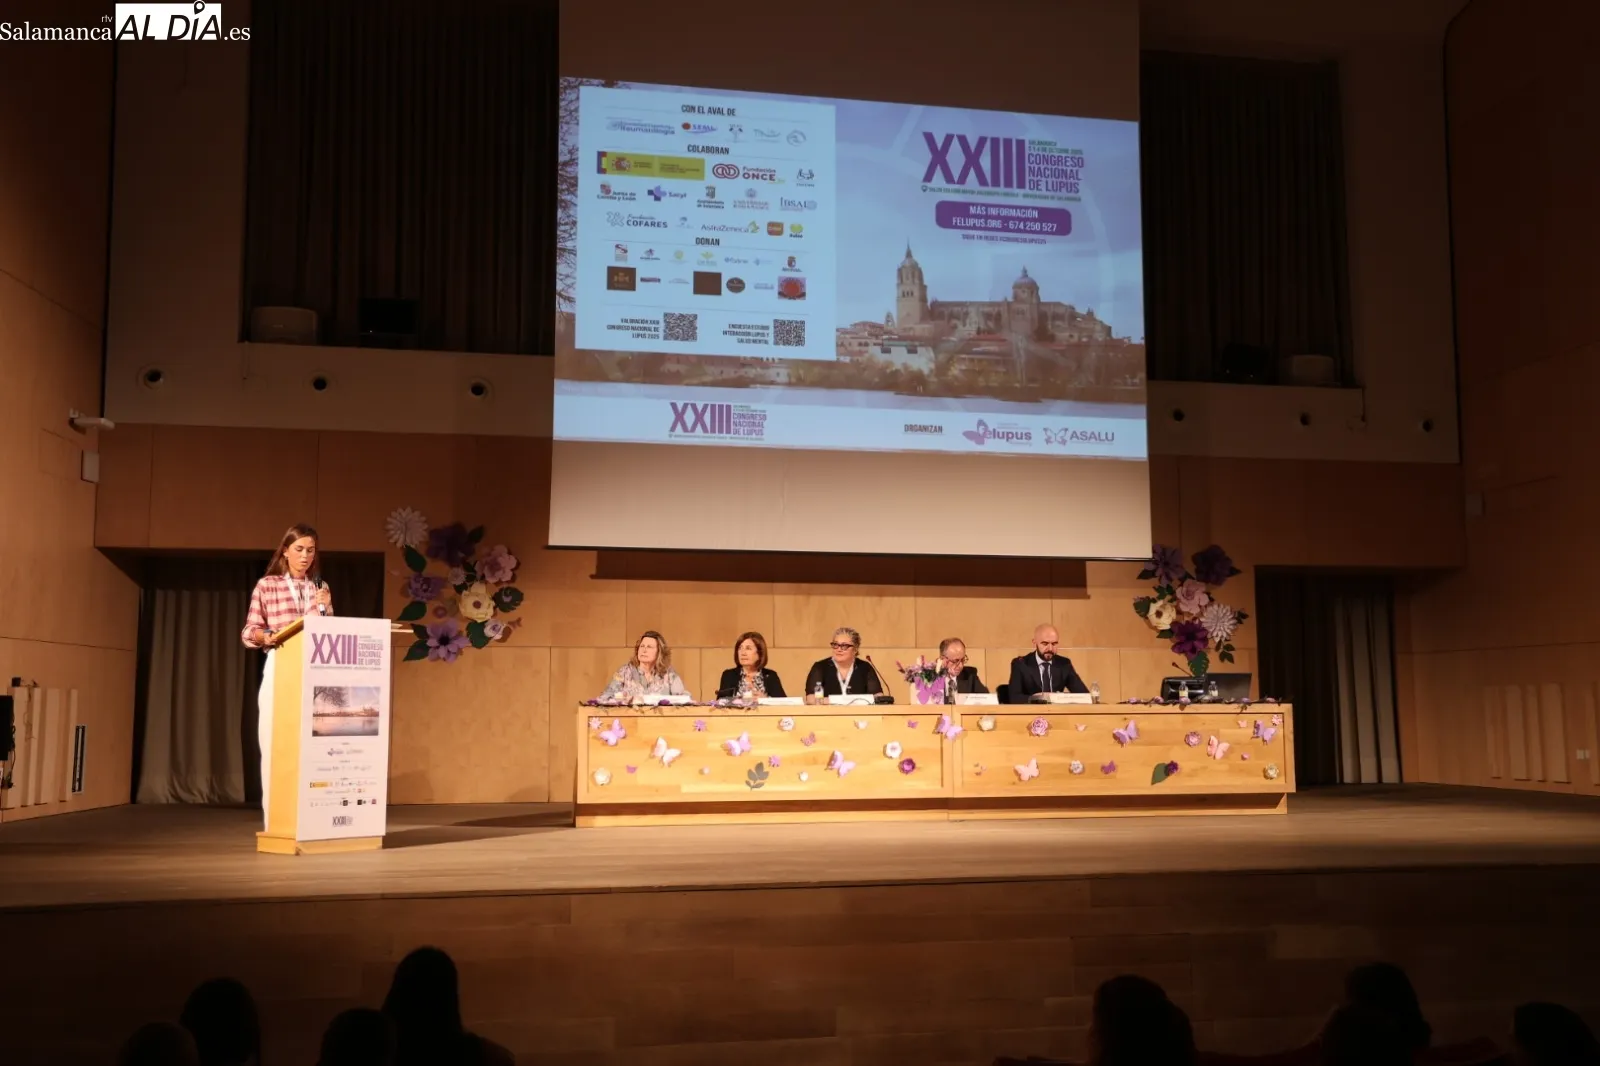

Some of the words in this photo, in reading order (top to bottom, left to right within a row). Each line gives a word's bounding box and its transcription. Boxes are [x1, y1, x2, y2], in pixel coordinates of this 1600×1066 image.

[681, 104, 696, 114] CON
[697, 106, 706, 114] EL
[707, 106, 726, 116] AVAL
[727, 108, 736, 116] DE
[687, 144, 730, 155] COLABORAN
[922, 131, 1026, 190] XXIII
[1028, 152, 1084, 168] CONGRESO
[742, 172, 776, 182] ONCE
[1028, 166, 1082, 181] NACIONAL
[1028, 178, 1042, 192] DE
[1045, 180, 1080, 194] LUPUS
[970, 204, 986, 216] MÁS
[988, 206, 1038, 218] INFORMACIÓN
[626, 219, 668, 228] COFARES
[952, 218, 1002, 229] FELUPUS.ORG
[1008, 220, 1024, 230] 674
[1042, 222, 1058, 232] 527
[696, 236, 720, 246] DONAN
[669, 402, 732, 434] XXIII
[732, 412, 767, 421] CONGRESO
[732, 420, 764, 428] NACIONAL
[904, 424, 943, 434] ORGANIZAN
[1070, 430, 1115, 442] ASALU
[310, 632, 358, 665] XXIII
